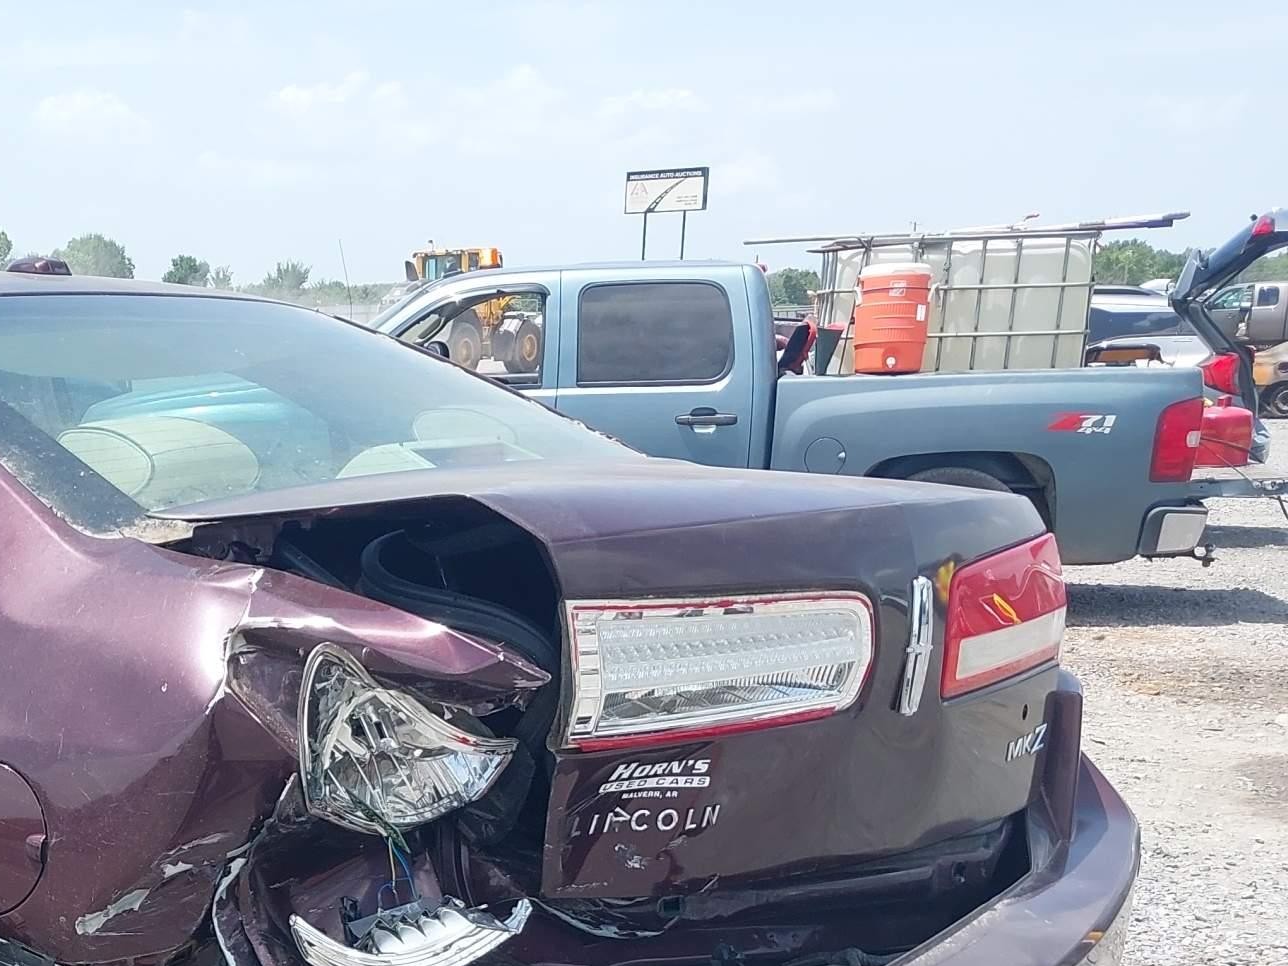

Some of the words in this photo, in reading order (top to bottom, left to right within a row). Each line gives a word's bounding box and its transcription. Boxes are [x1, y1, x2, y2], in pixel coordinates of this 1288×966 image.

[1006, 722, 1048, 762] MKZ
[602, 779, 648, 792] USED
[655, 776, 708, 787] CARS
[621, 790, 663, 800] MALVERN,
[665, 790, 678, 799] AR
